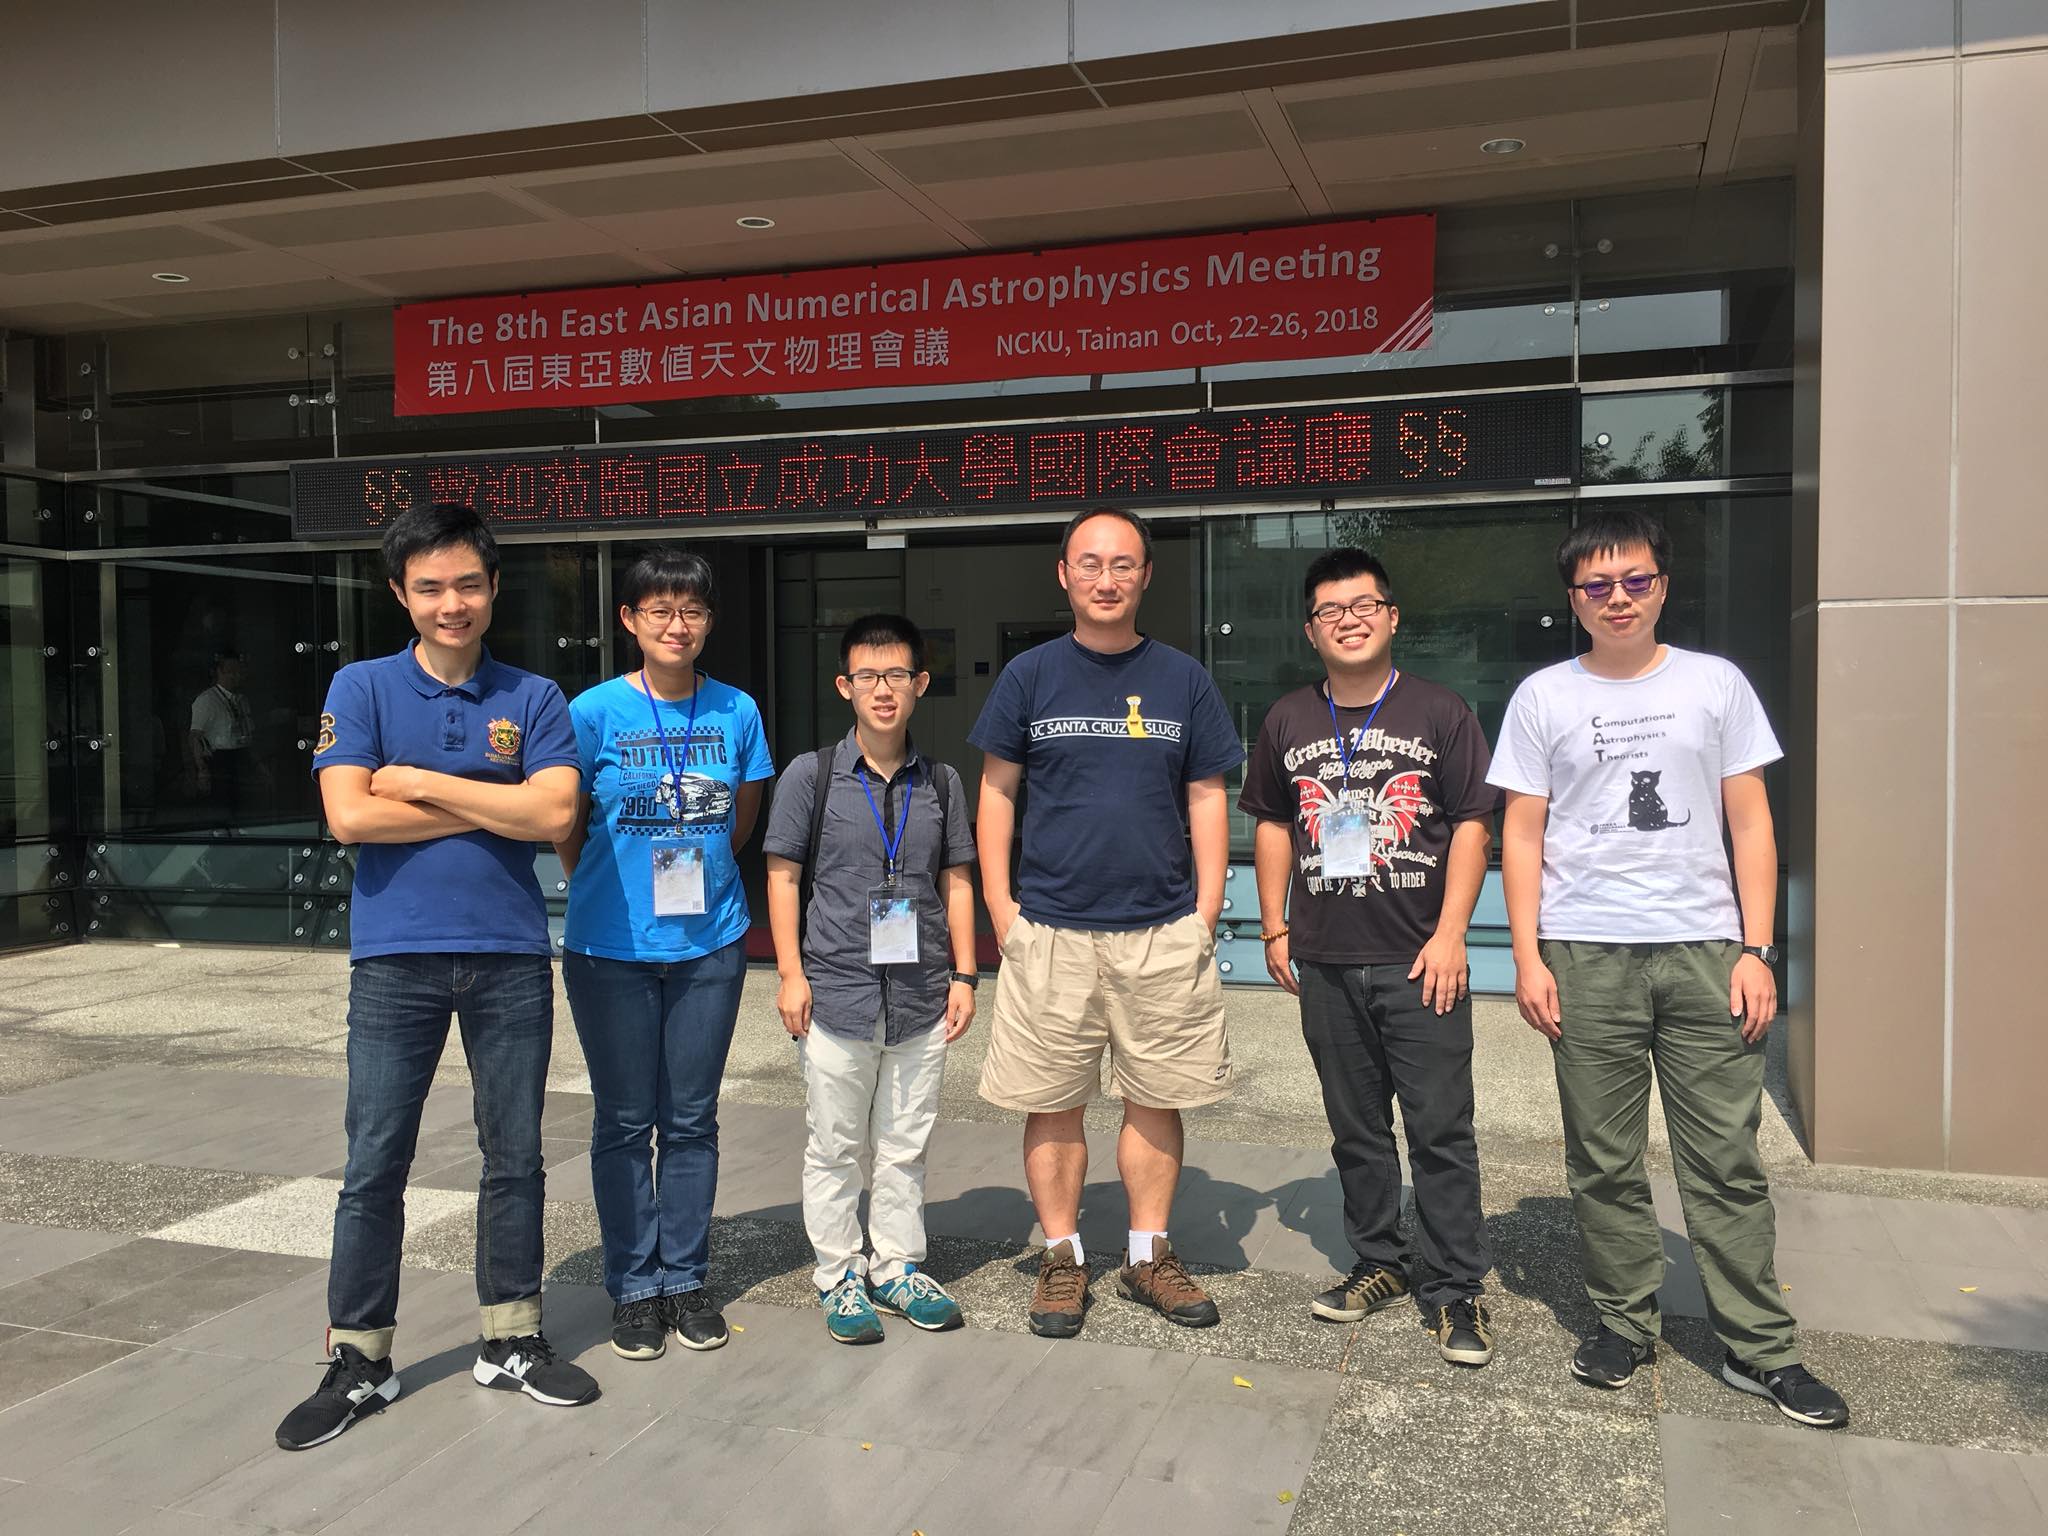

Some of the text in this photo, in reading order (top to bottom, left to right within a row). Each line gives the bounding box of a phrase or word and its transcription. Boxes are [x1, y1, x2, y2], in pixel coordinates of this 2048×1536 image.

[428, 243, 1381, 347] The 8th East Asian Numerical Astrophysics Meeting
[997, 305, 1378, 358] NCKU, Tainan Oct, 22-26, 2018
[427, 327, 950, 398] 第八屆東亞數值天文物理會議
[1591, 712, 1676, 729] Computational
[1030, 721, 1181, 738] UC SANTA CRUZ SLUGS
[1593, 731, 1667, 746] Astrophysics
[620, 744, 728, 768] AUTHENTIC
[1594, 749, 1649, 763] Theorists
[637, 781, 656, 790] DIEGO
[1389, 873, 1400, 889] TO
[1401, 872, 1426, 888] RIDER
